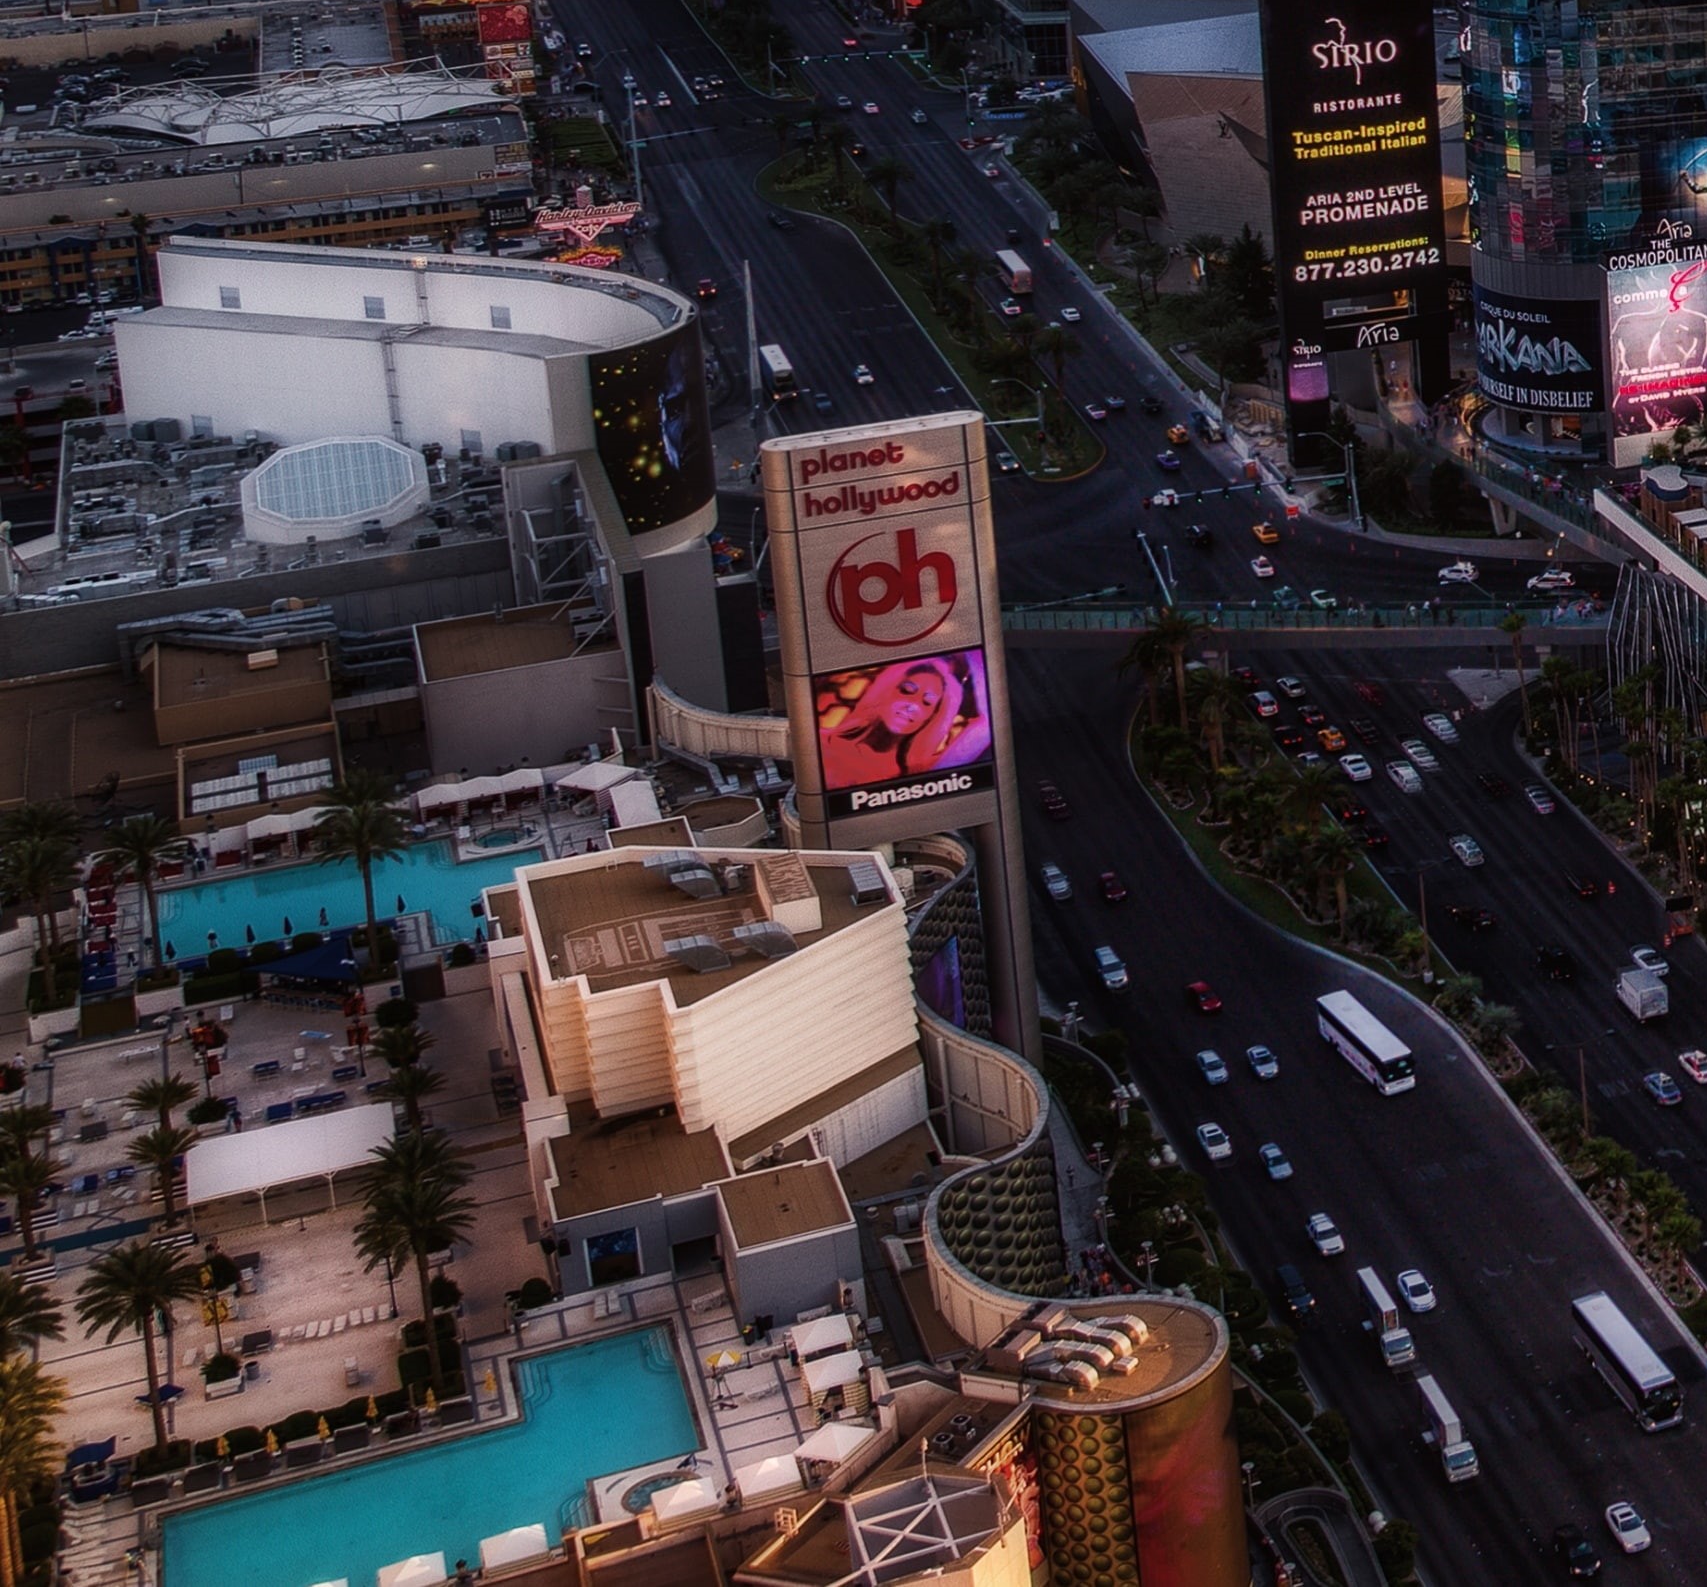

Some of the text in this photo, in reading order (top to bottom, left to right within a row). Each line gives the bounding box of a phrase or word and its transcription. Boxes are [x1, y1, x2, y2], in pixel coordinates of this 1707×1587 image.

[1312, 38, 1397, 85] SIRIO
[1313, 93, 1403, 114] RISTORANTE
[1292, 117, 1427, 145] Tuscan-Inspired
[1294, 134, 1427, 160] Traditional Italian
[1306, 182, 1423, 207] ARIA 2ND LEVEL
[1300, 194, 1429, 226] PROMENADE
[1656, 217, 1693, 240] Aria
[1304, 235, 1430, 261] Dinner Reservations:
[1650, 239, 1672, 250] THE
[1294, 247, 1441, 282] 877.230.2742
[1503, 309, 1516, 320] DU
[1517, 312, 1552, 324] SOLEIL
[1356, 322, 1401, 349] Aria
[1476, 318, 1593, 376] ARKANA
[1517, 387, 1529, 403] IN
[1530, 389, 1594, 408] DISBELIEF
[1640, 391, 1671, 402] DAVID
[801, 441, 905, 486] planet
[804, 471, 960, 517] hollywood
[840, 527, 958, 639] ph
[851, 772, 973, 812] Panasonic
